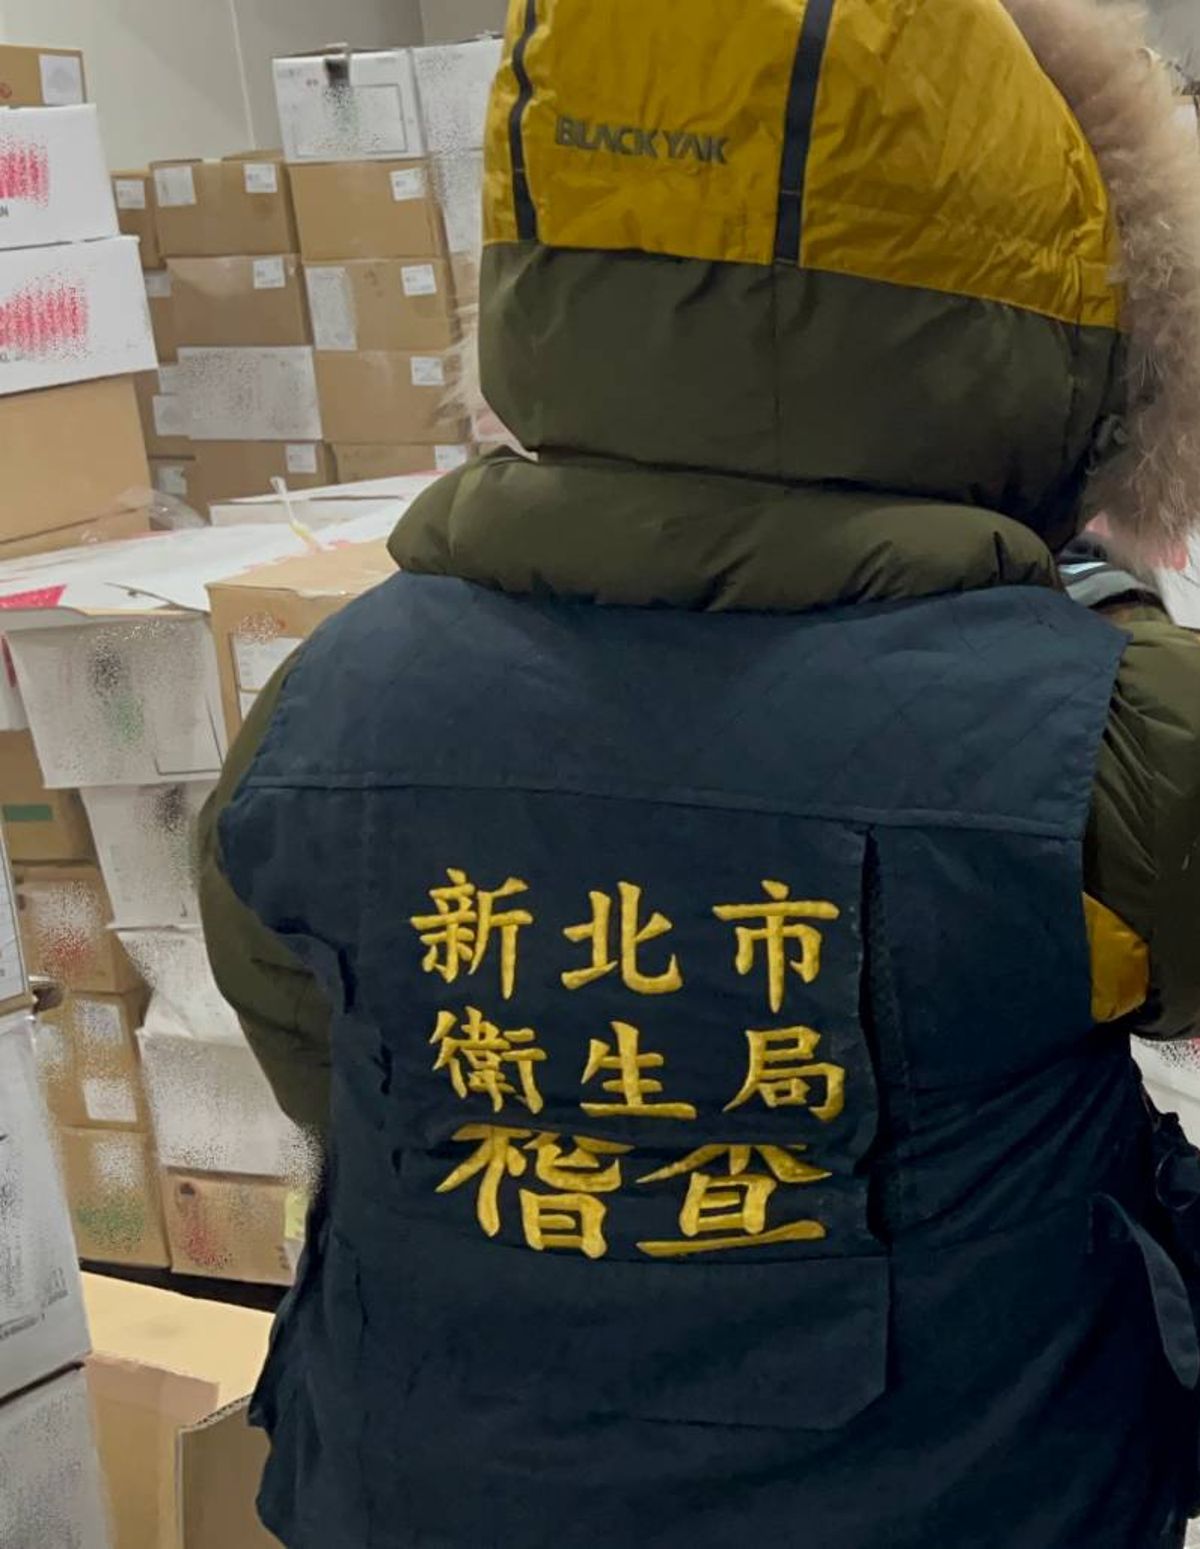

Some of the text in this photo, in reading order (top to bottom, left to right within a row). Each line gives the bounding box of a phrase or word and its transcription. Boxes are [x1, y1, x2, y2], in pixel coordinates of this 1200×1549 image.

[411, 868, 840, 1013] 新北市
[429, 1006, 845, 1121] 衛生局
[435, 1124, 832, 1259] 稽查
